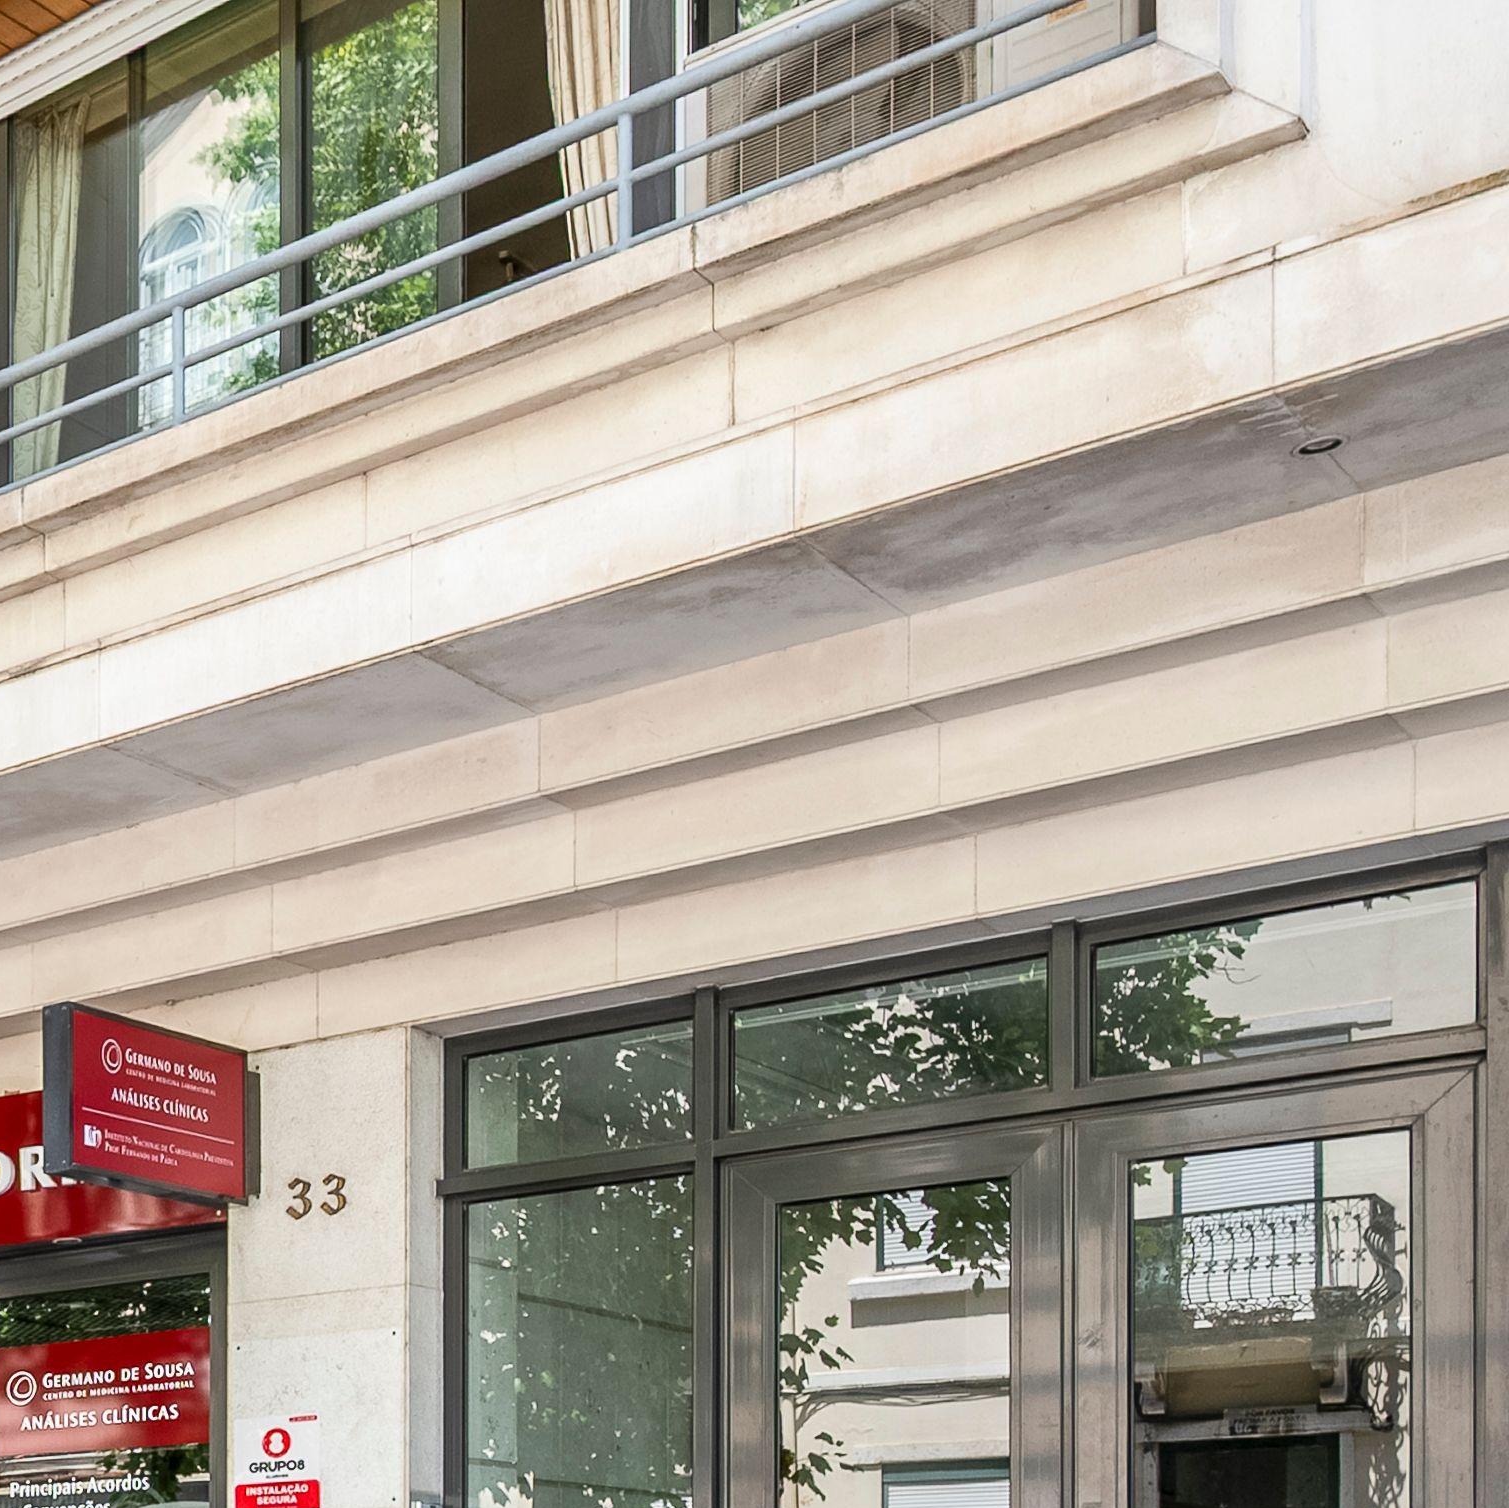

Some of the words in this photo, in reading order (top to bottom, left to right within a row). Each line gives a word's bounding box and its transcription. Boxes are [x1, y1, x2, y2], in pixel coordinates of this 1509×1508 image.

[125, 1048, 171, 1074] GERMANO
[173, 1063, 185, 1078] DE
[188, 1064, 217, 1085] SOUSA
[111, 1087, 161, 1111] ANÁLISES
[163, 1099, 210, 1123] CLÍNICAS
[286, 1173, 347, 1220] 33
[42, 1370, 116, 1390] GERMANO
[120, 1366, 140, 1382] DE
[144, 1361, 195, 1382] SOUSA
[42, 1391, 74, 1402] CENTRO
[76, 1389, 87, 1399] DE
[90, 1386, 130, 1397] MEDICINA
[132, 1380, 195, 1394] LABORATORIAL
[20, 1410, 97, 1431] ANÁLISES
[102, 1403, 179, 1425] CLÍNICAS
[249, 1459, 305, 1473] GRUPO8
[9, 1476, 83, 1499] Principais
[87, 1473, 150, 1494] Acordos
[245, 1483, 309, 1497] INSTALAÇÃO
[256, 1494, 298, 1506] SEGURA
